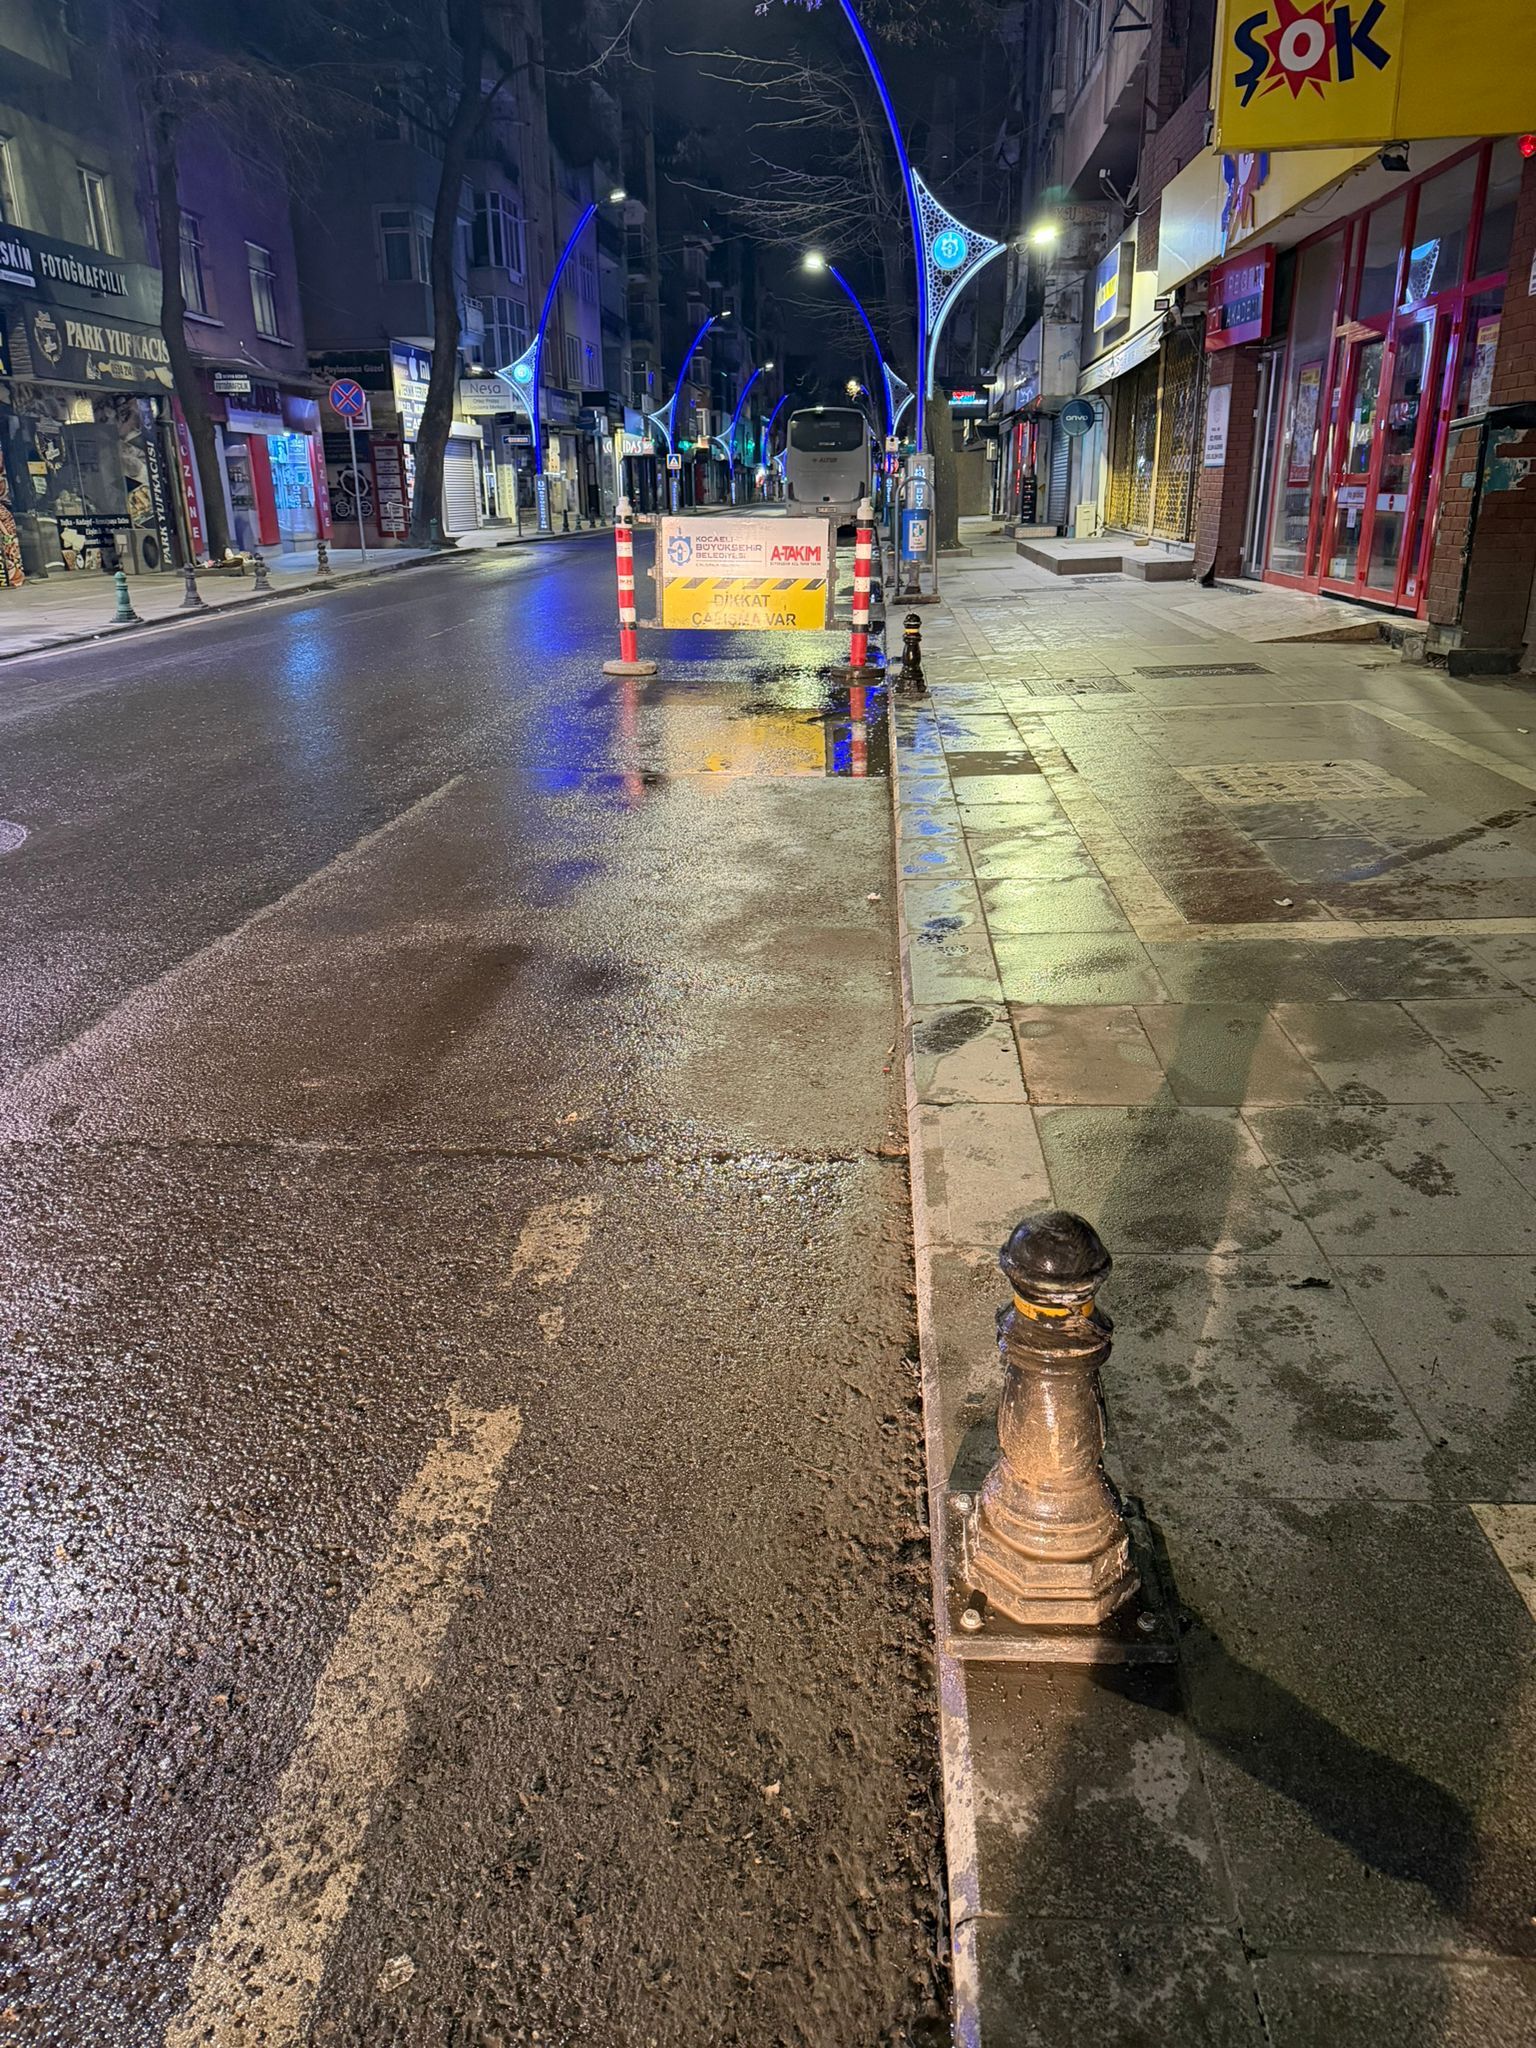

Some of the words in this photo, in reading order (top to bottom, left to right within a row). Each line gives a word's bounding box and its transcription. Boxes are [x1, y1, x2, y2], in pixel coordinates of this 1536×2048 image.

[1234, 0, 1391, 108] ŞOK
[0, 239, 34, 272] SKİN
[65, 319, 106, 353] PARK
[105, 329, 171, 363] YUFKACIS
[470, 383, 502, 395] Nesa
[145, 440, 168, 524] YUFKACISI
[158, 525, 173, 565] PARK
[765, 613, 797, 626] VAR
